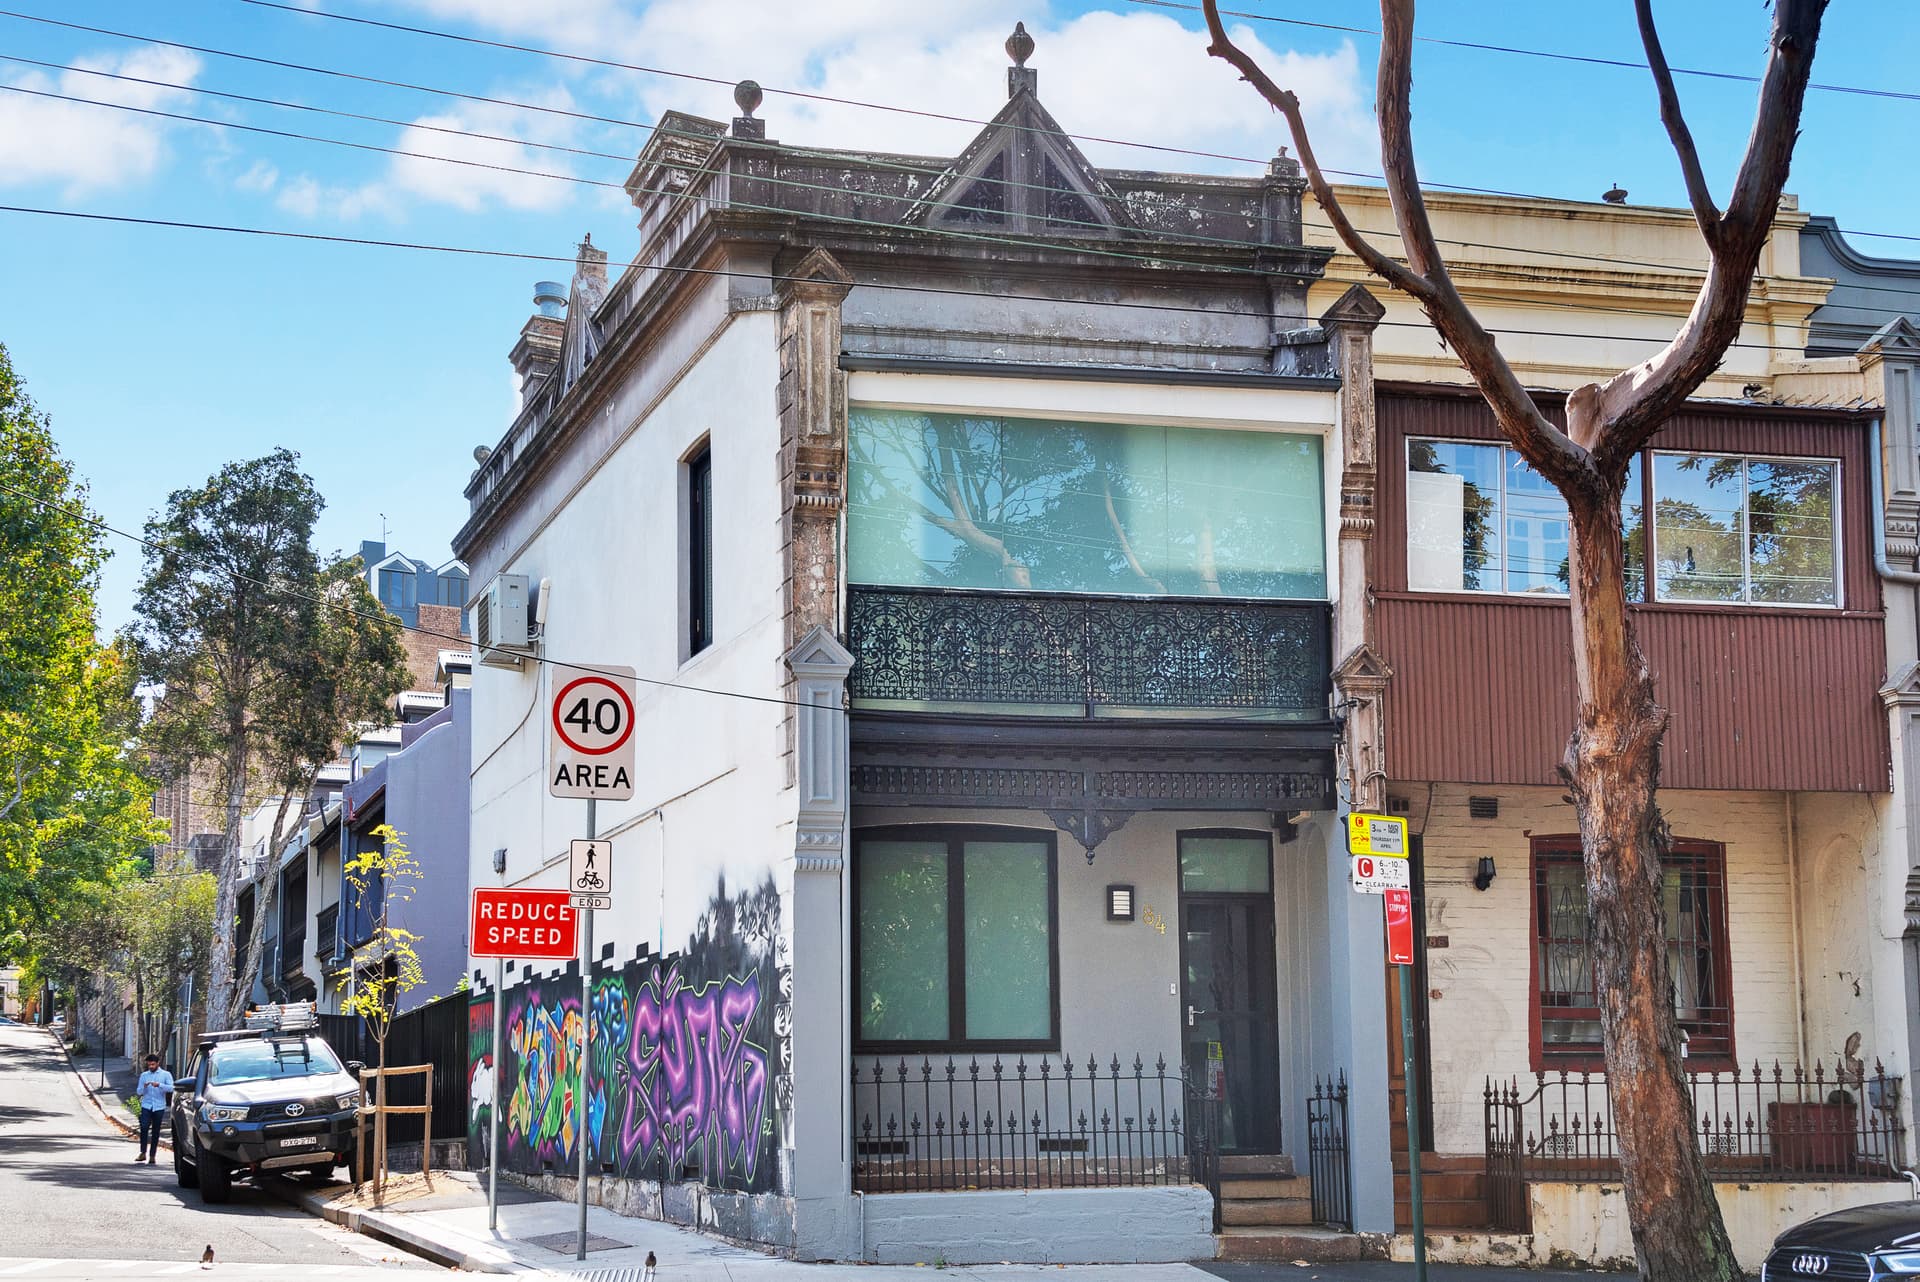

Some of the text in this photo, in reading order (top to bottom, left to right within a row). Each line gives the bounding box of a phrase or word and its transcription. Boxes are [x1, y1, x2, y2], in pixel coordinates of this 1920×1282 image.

[563, 697, 621, 735] 40
[553, 763, 631, 789] AREA
[1360, 859, 1370, 877] C
[579, 898, 602, 907] END
[1389, 903, 1407, 913] STOPPING
[1393, 894, 1401, 903] NO
[480, 902, 571, 921] REDUCE
[1142, 903, 1166, 934] 84
[487, 926, 561, 945] SPEED
